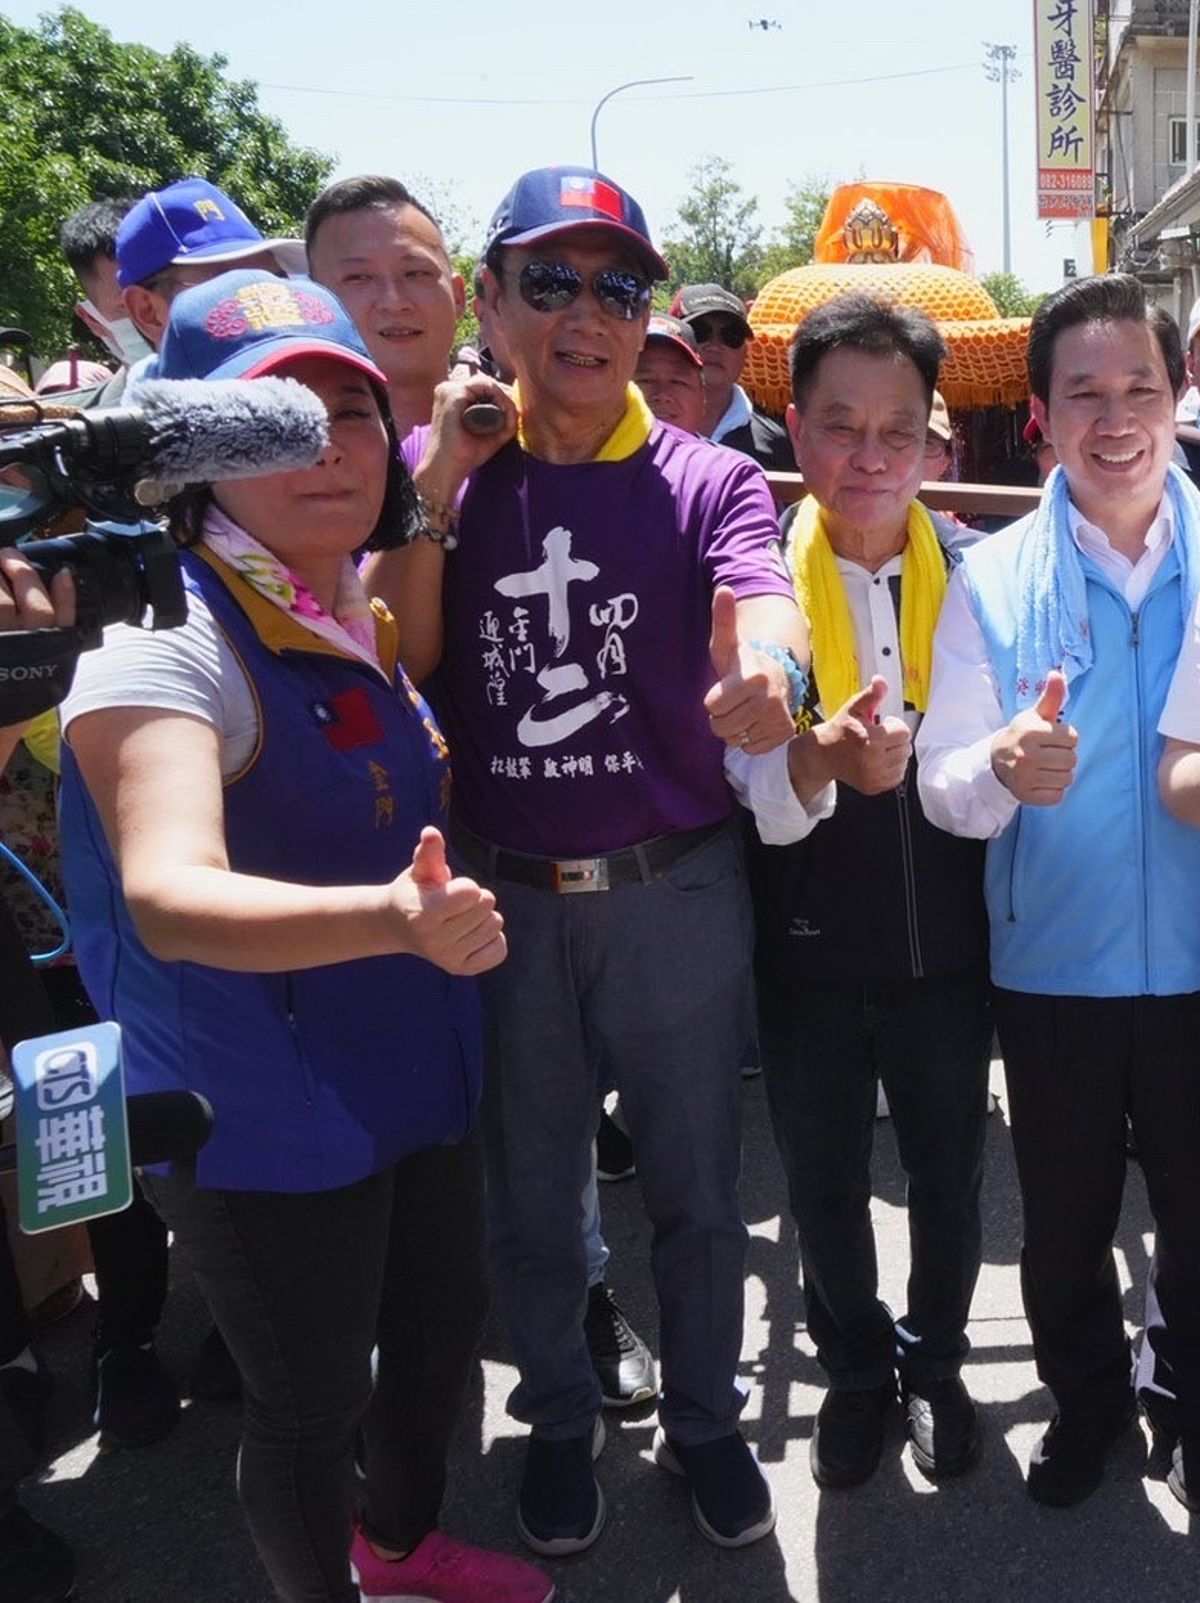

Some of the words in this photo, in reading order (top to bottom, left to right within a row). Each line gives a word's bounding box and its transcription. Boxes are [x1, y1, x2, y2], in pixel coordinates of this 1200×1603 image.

[1045, 0, 1086, 164] 牙醫診所
[508, 606, 537, 674] 金門
[35, 1105, 108, 1214] 華視
